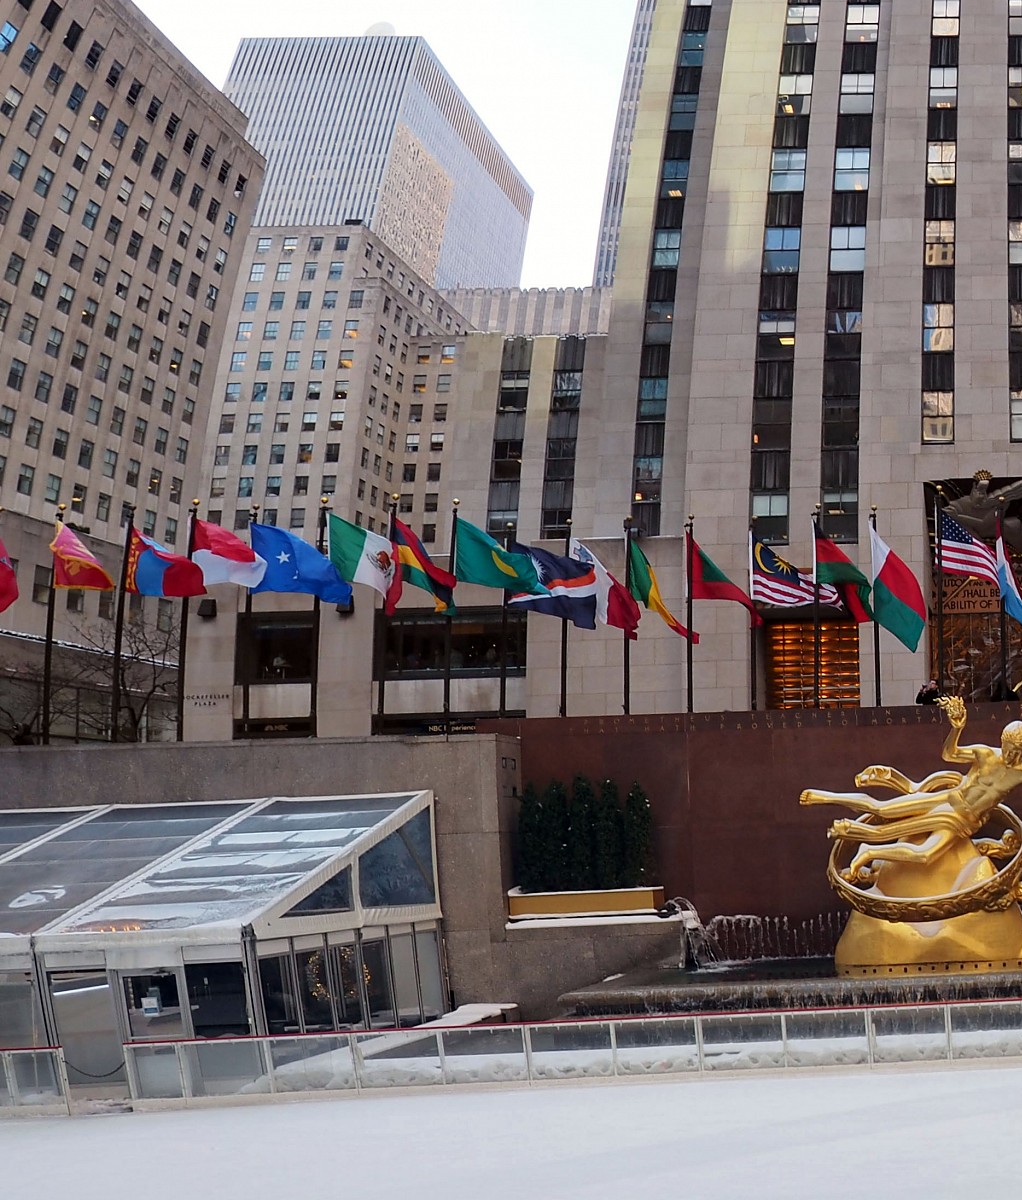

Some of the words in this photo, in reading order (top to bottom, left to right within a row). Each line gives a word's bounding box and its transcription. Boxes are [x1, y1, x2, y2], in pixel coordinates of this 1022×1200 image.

[962, 589, 988, 598] SHALL
[989, 589, 1000, 598] BE
[933, 600, 977, 610] SABILITY
[979, 600, 993, 610] OF
[827, 719, 848, 727] TO
[443, 724, 476, 732] perienc
